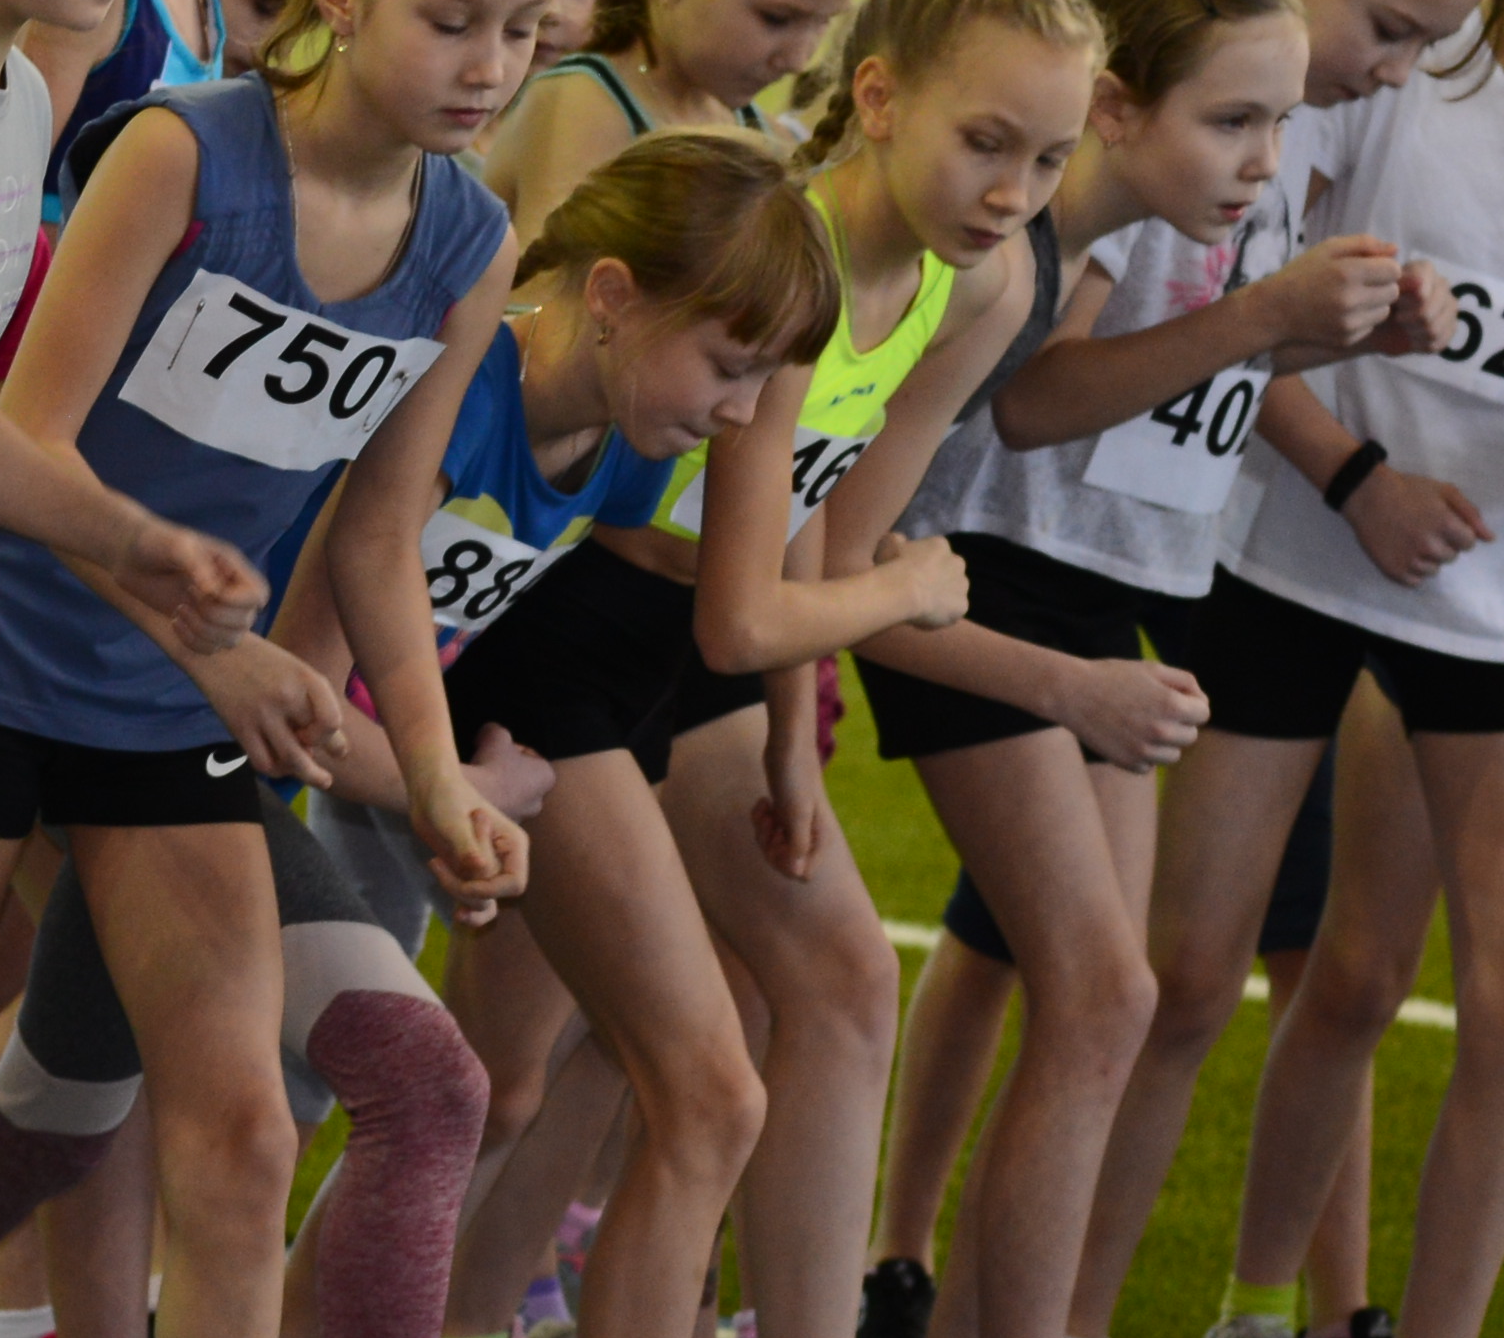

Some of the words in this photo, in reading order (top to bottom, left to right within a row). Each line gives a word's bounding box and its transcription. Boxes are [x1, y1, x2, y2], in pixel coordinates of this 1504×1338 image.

[201, 292, 398, 422] 750
[1150, 376, 1268, 457] 40
[424, 538, 545, 620] 88
